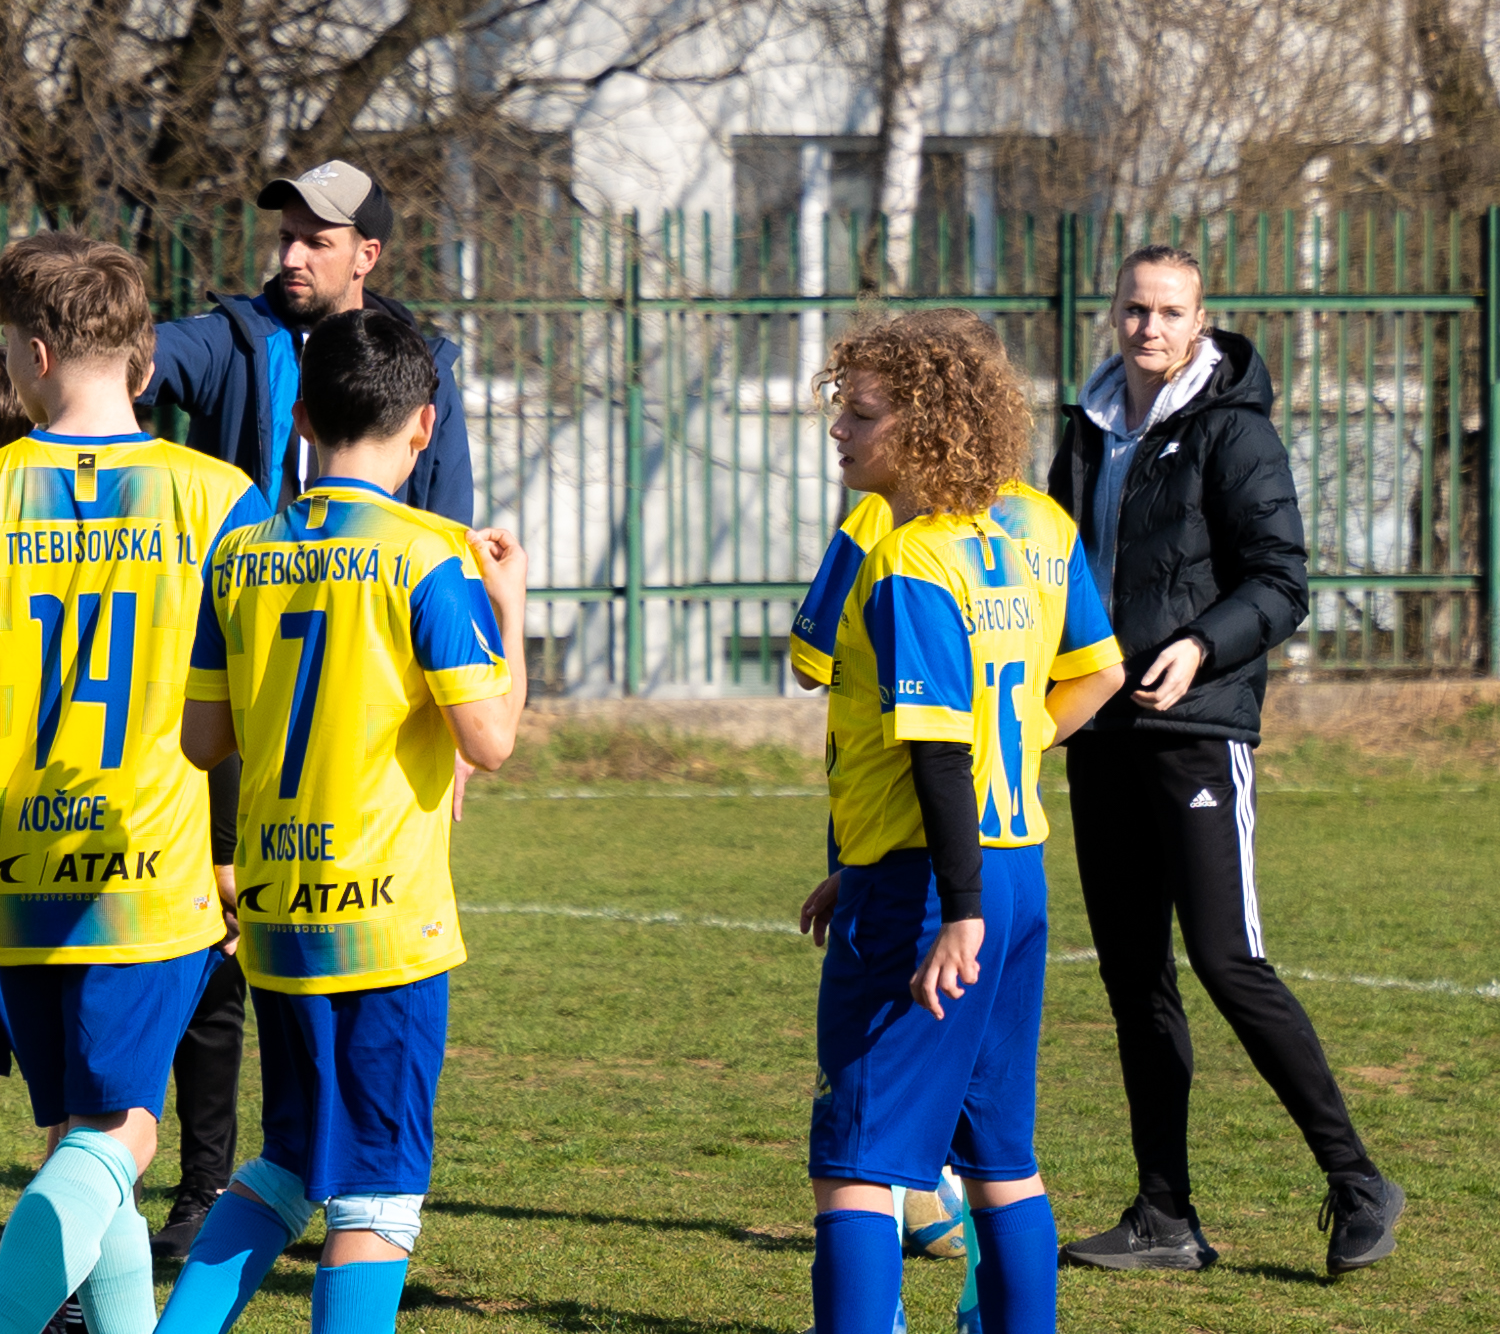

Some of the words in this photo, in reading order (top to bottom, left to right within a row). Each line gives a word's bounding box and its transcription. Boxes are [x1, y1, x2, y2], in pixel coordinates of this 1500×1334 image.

[6, 523, 163, 566] TREBIŠOVSKÁ
[235, 543, 381, 588] TREBIŠOVSKÁ
[1047, 556, 1066, 587] 10
[31, 592, 138, 771] 14
[279, 610, 325, 800] 7
[18, 789, 107, 832] KOŠICE
[261, 816, 336, 861] KOŠICE
[53, 851, 162, 883] ATAK
[289, 875, 395, 914] ATAK
